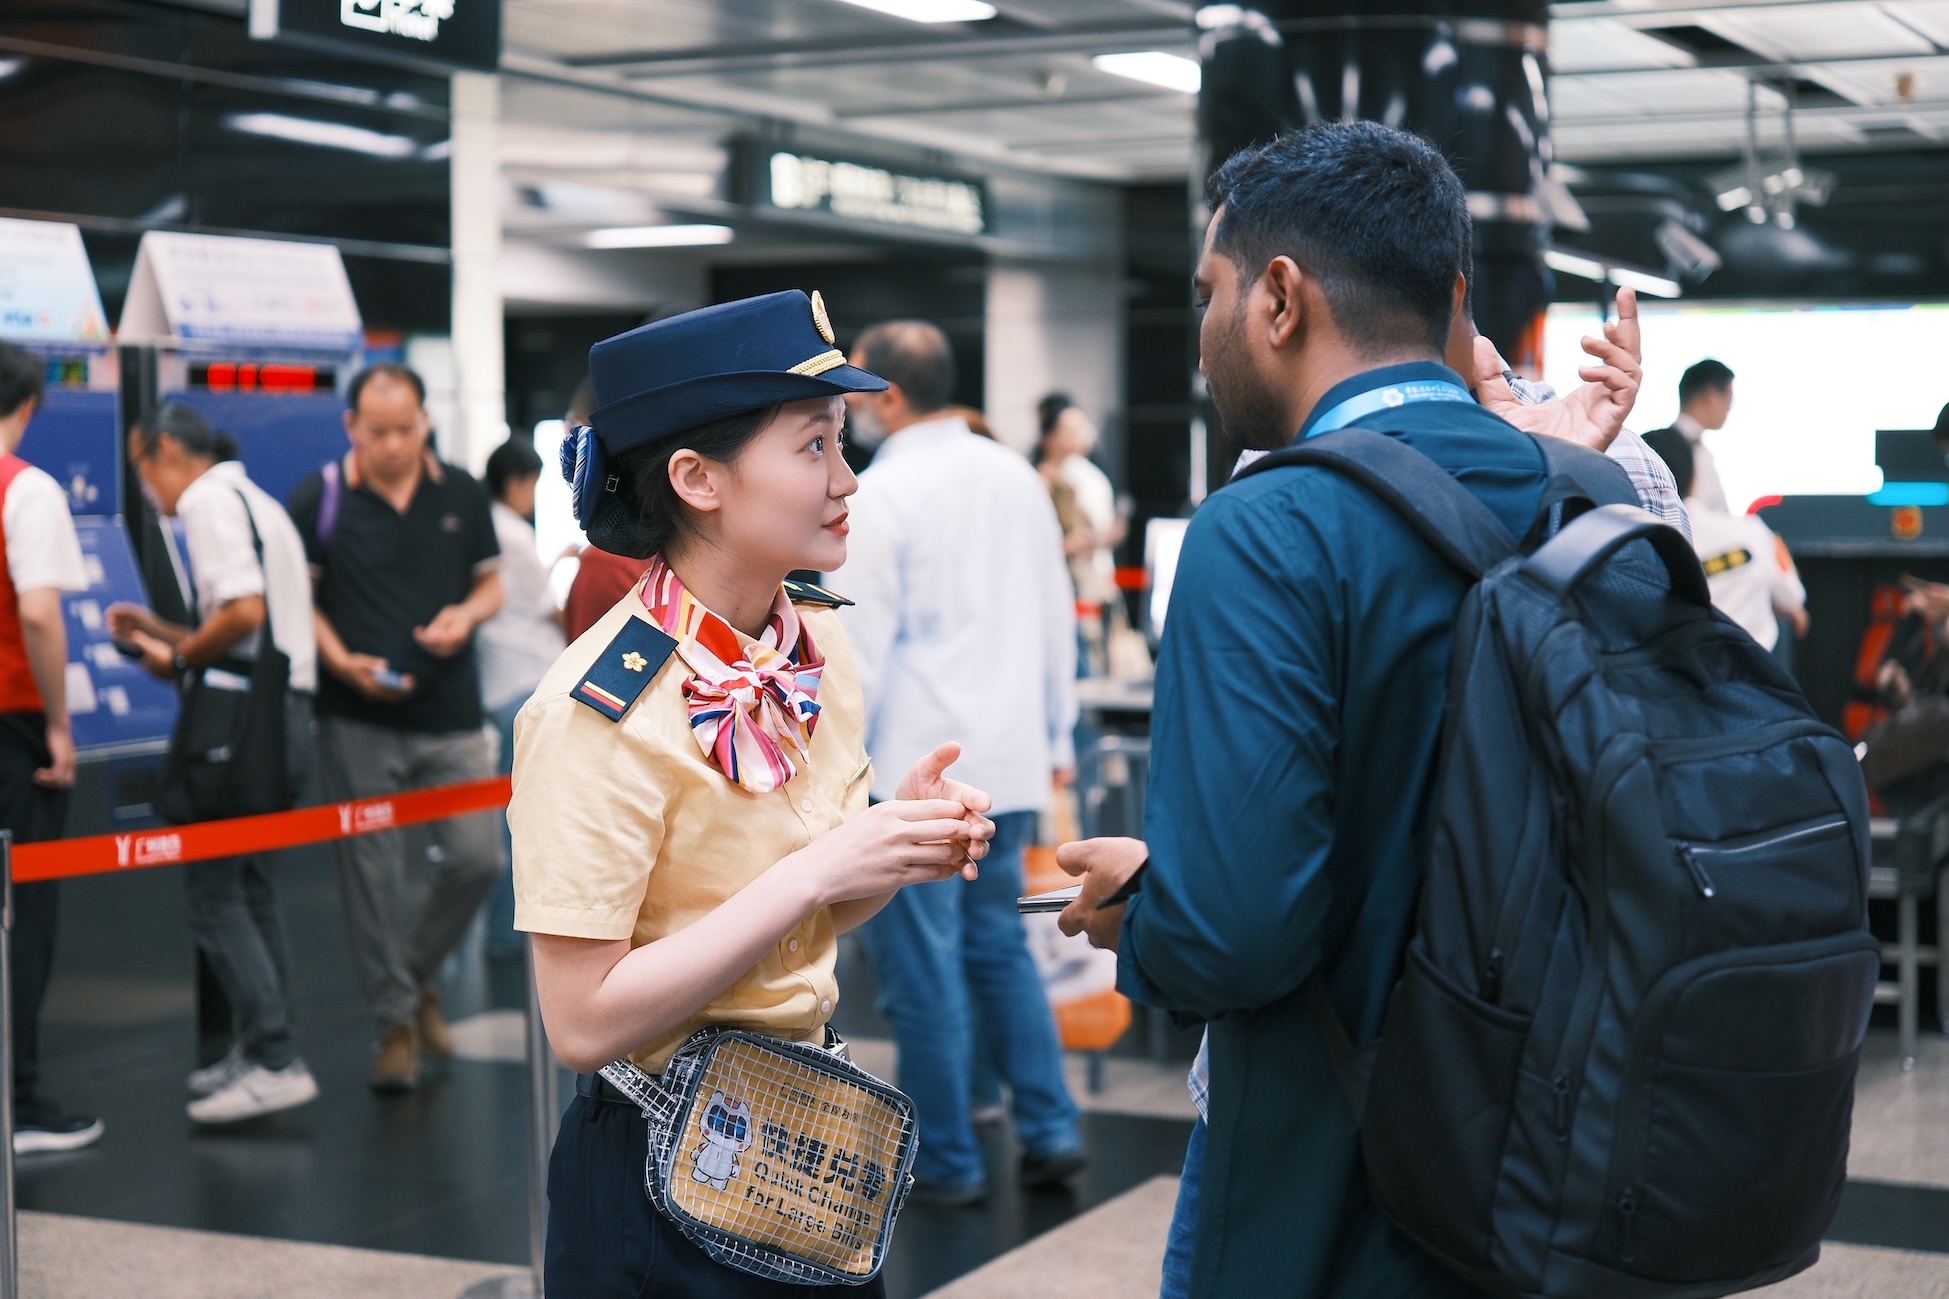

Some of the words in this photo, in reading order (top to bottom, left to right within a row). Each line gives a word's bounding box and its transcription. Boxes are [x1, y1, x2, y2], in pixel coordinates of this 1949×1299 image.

[821, 1101, 859, 1123] 全程为你
[761, 1117, 886, 1201] 快捷兑零
[745, 1185, 775, 1209] for
[776, 1197, 826, 1233] Large
[831, 1221, 862, 1250] Bills
[754, 1161, 804, 1198] Quick
[808, 1186, 871, 1227] Change
